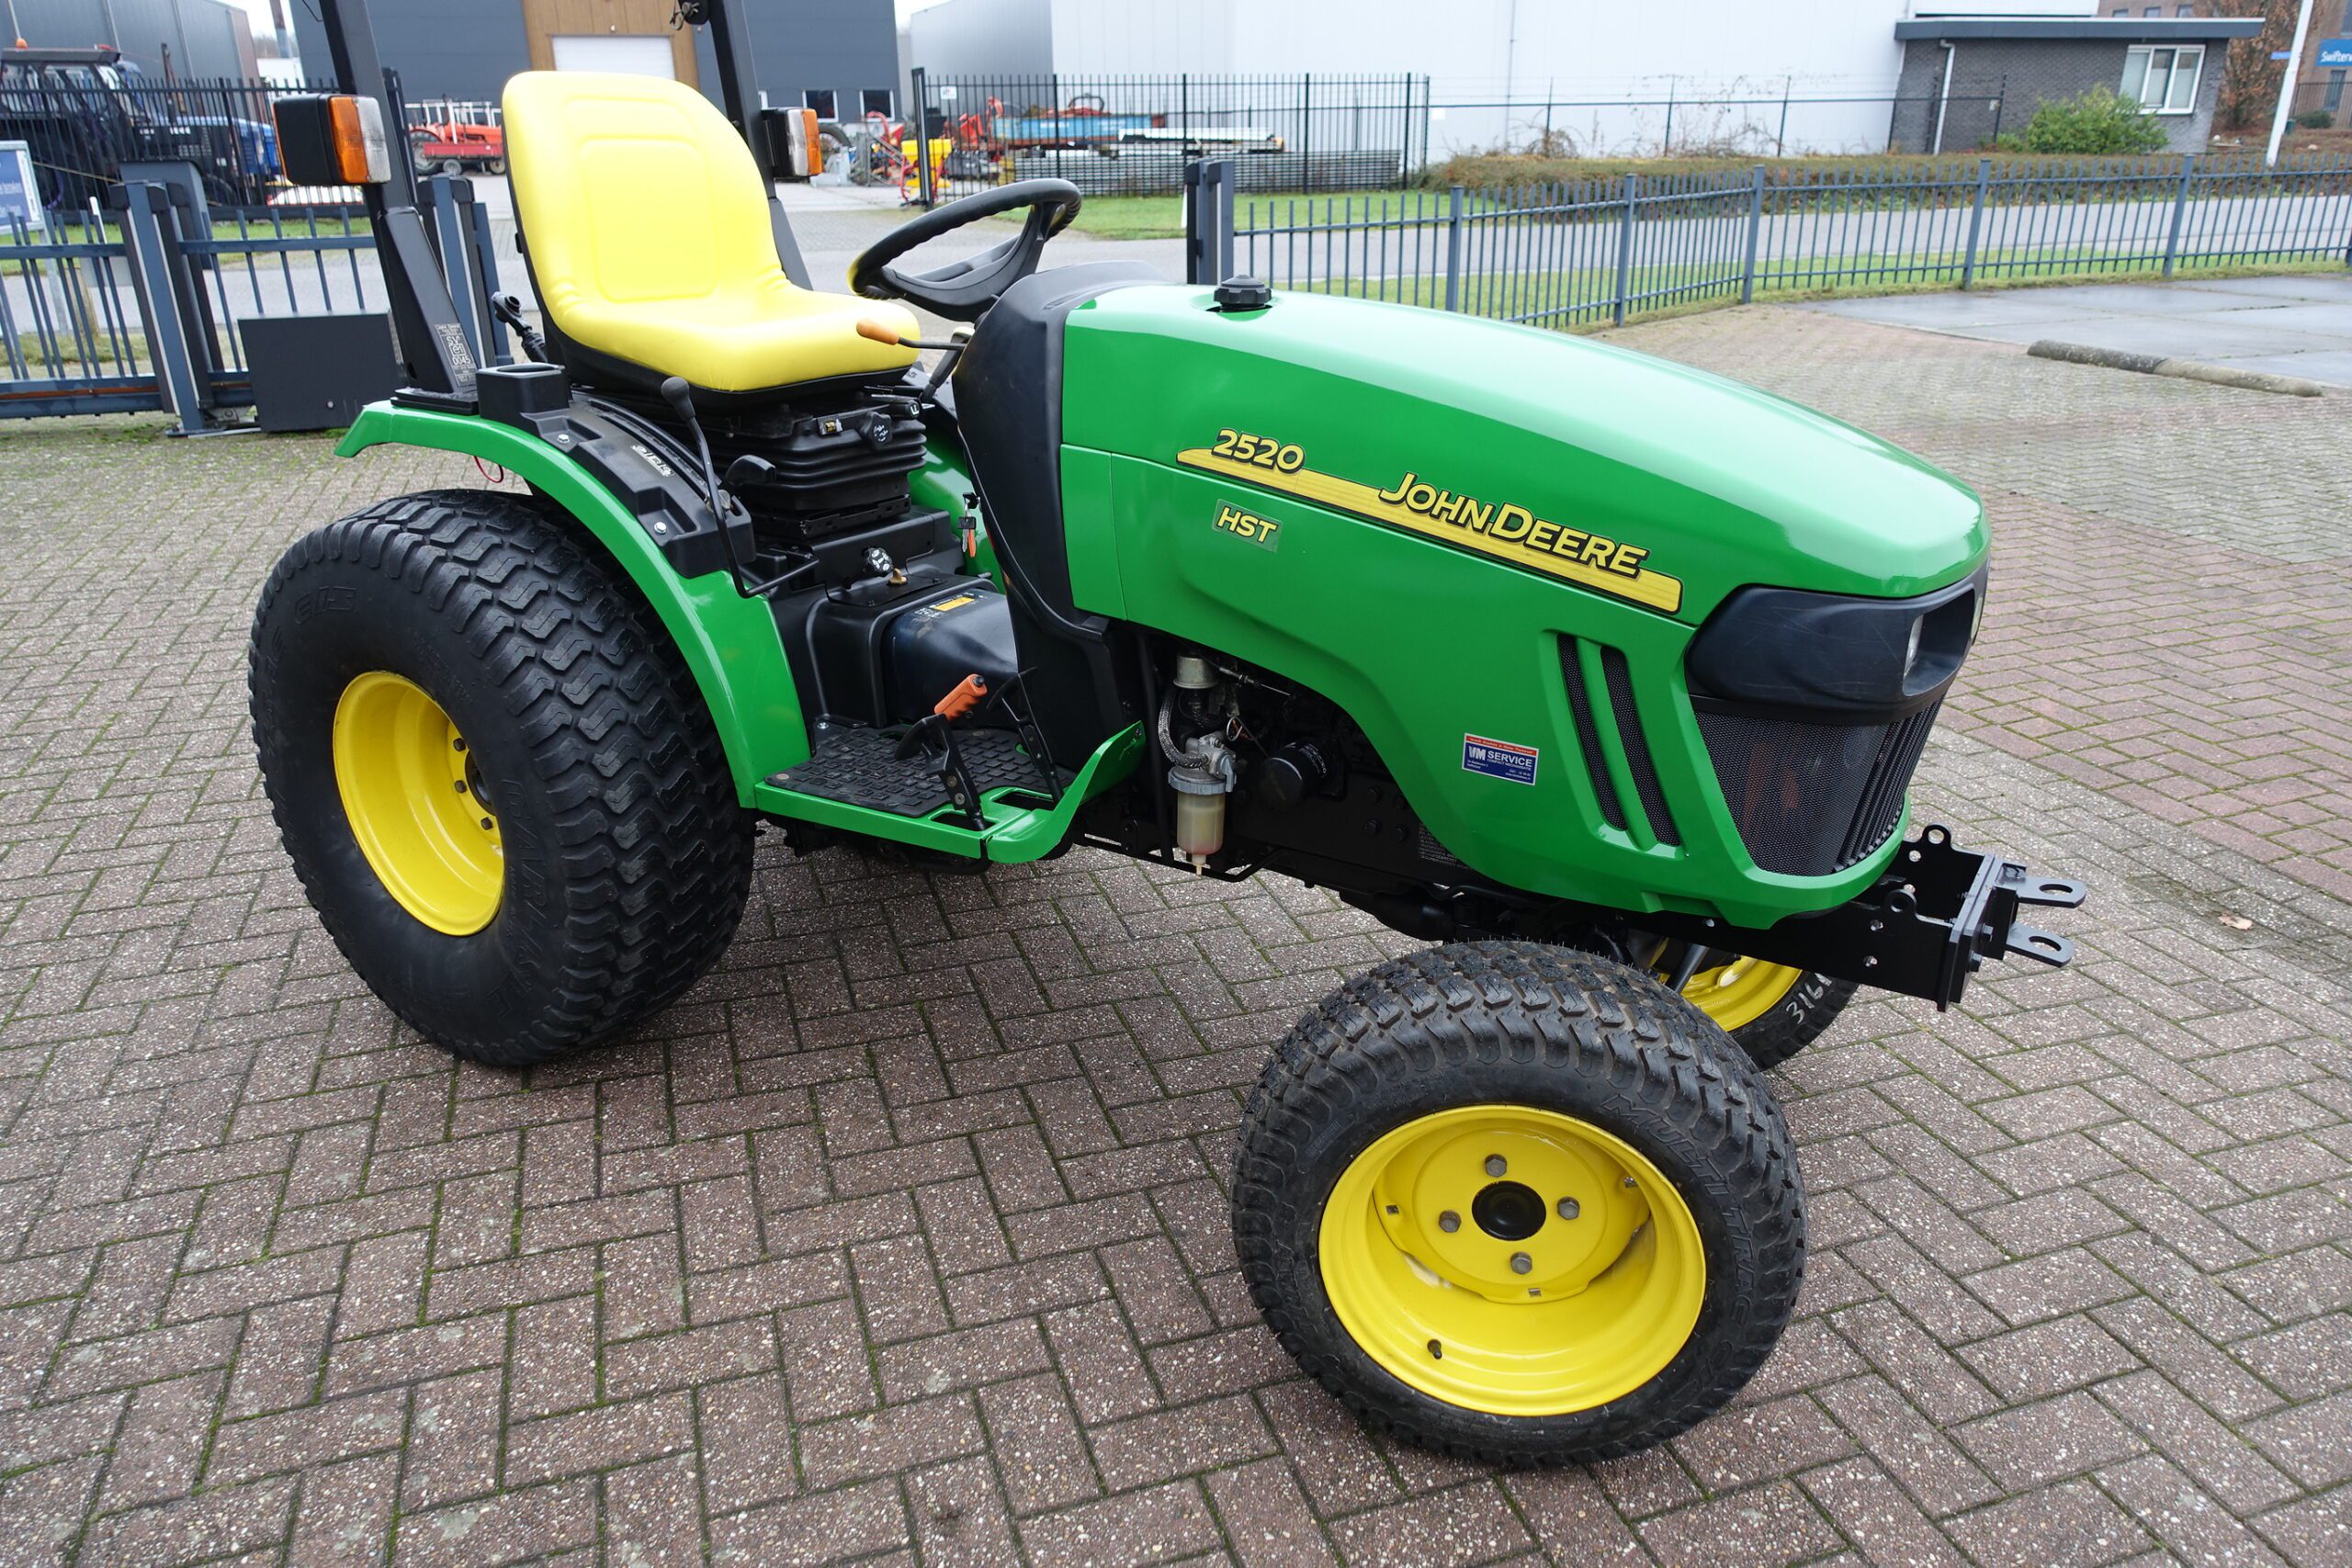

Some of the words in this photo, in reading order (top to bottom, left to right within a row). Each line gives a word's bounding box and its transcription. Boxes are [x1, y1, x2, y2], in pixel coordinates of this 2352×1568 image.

[1212, 428, 1306, 474] 2520
[1216, 506, 1279, 543] HST
[1378, 471, 1496, 535] JOHN
[1487, 502, 1651, 581] DEERE
[1487, 750, 1533, 768] SERVICE
[1601, 1092, 1730, 1195] MULTI
[1721, 1206, 1755, 1325] TRAC
